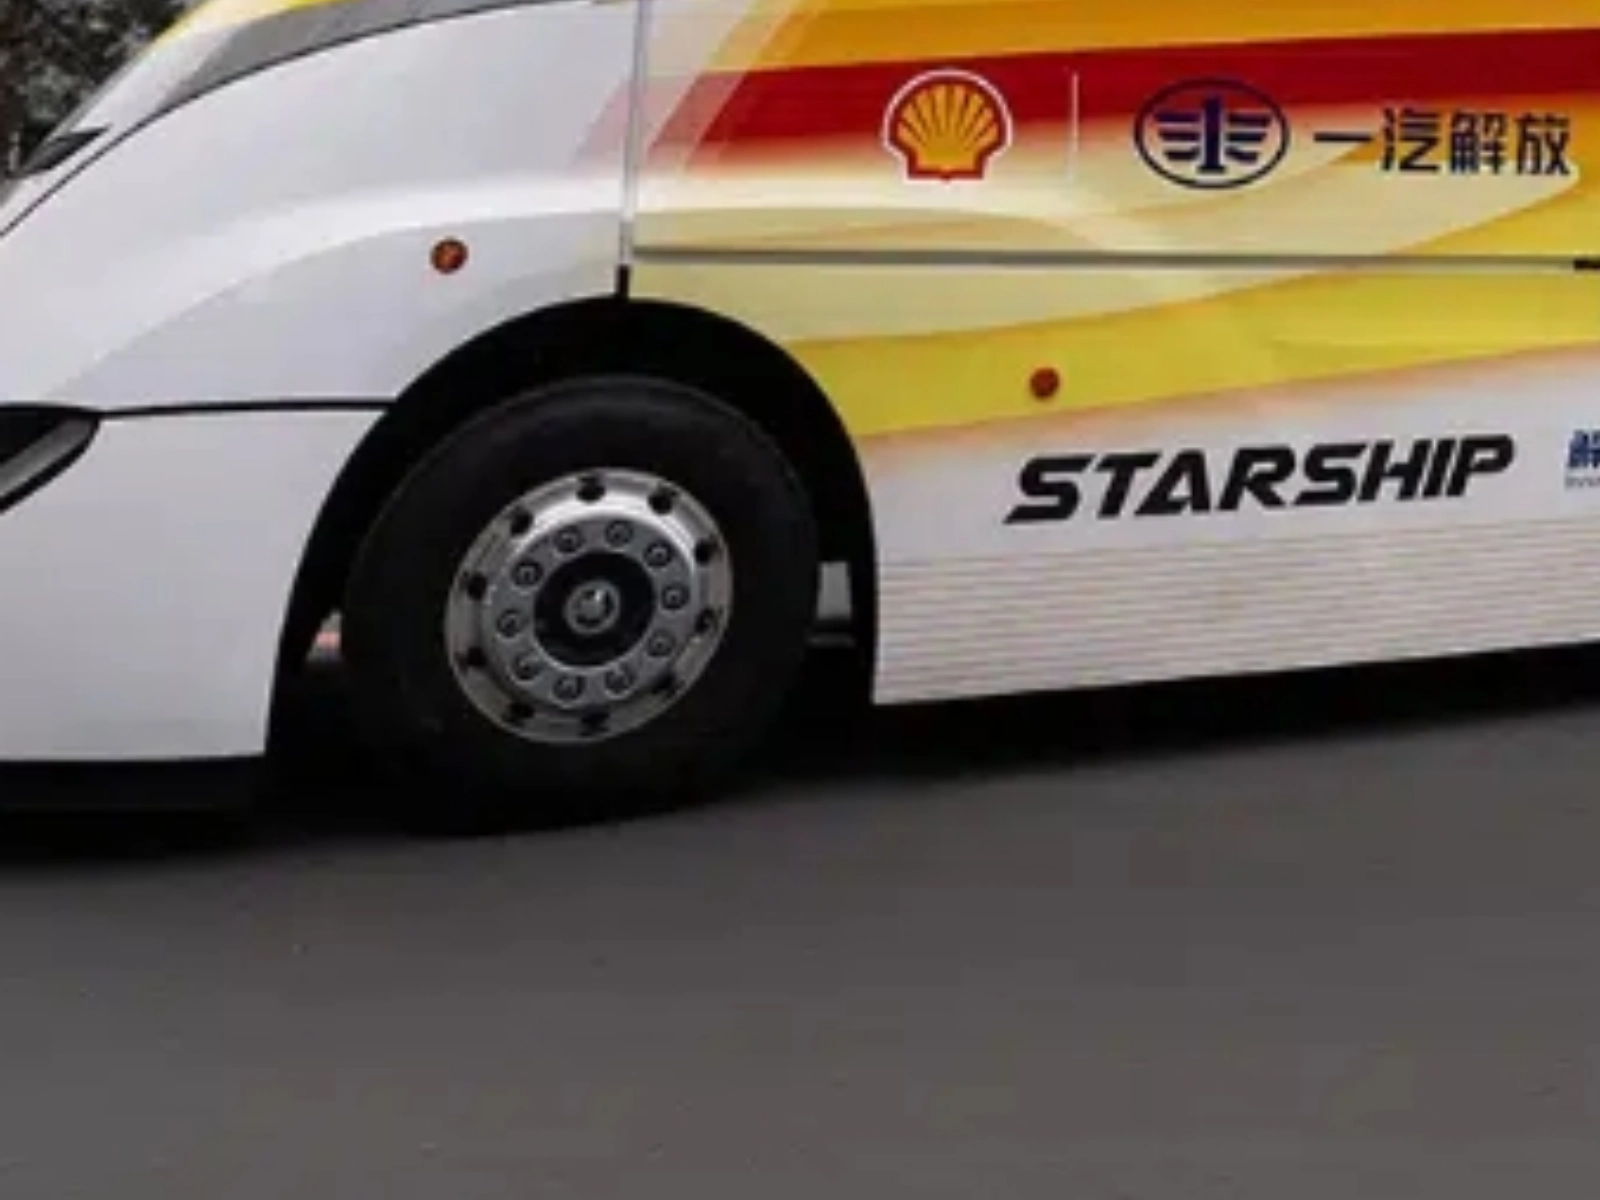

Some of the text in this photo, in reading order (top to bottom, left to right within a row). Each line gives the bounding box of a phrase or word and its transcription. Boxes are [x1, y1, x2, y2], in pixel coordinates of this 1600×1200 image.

[1313, 106, 1572, 177] 一汽解放
[1003, 433, 1516, 524] STARSHIP
